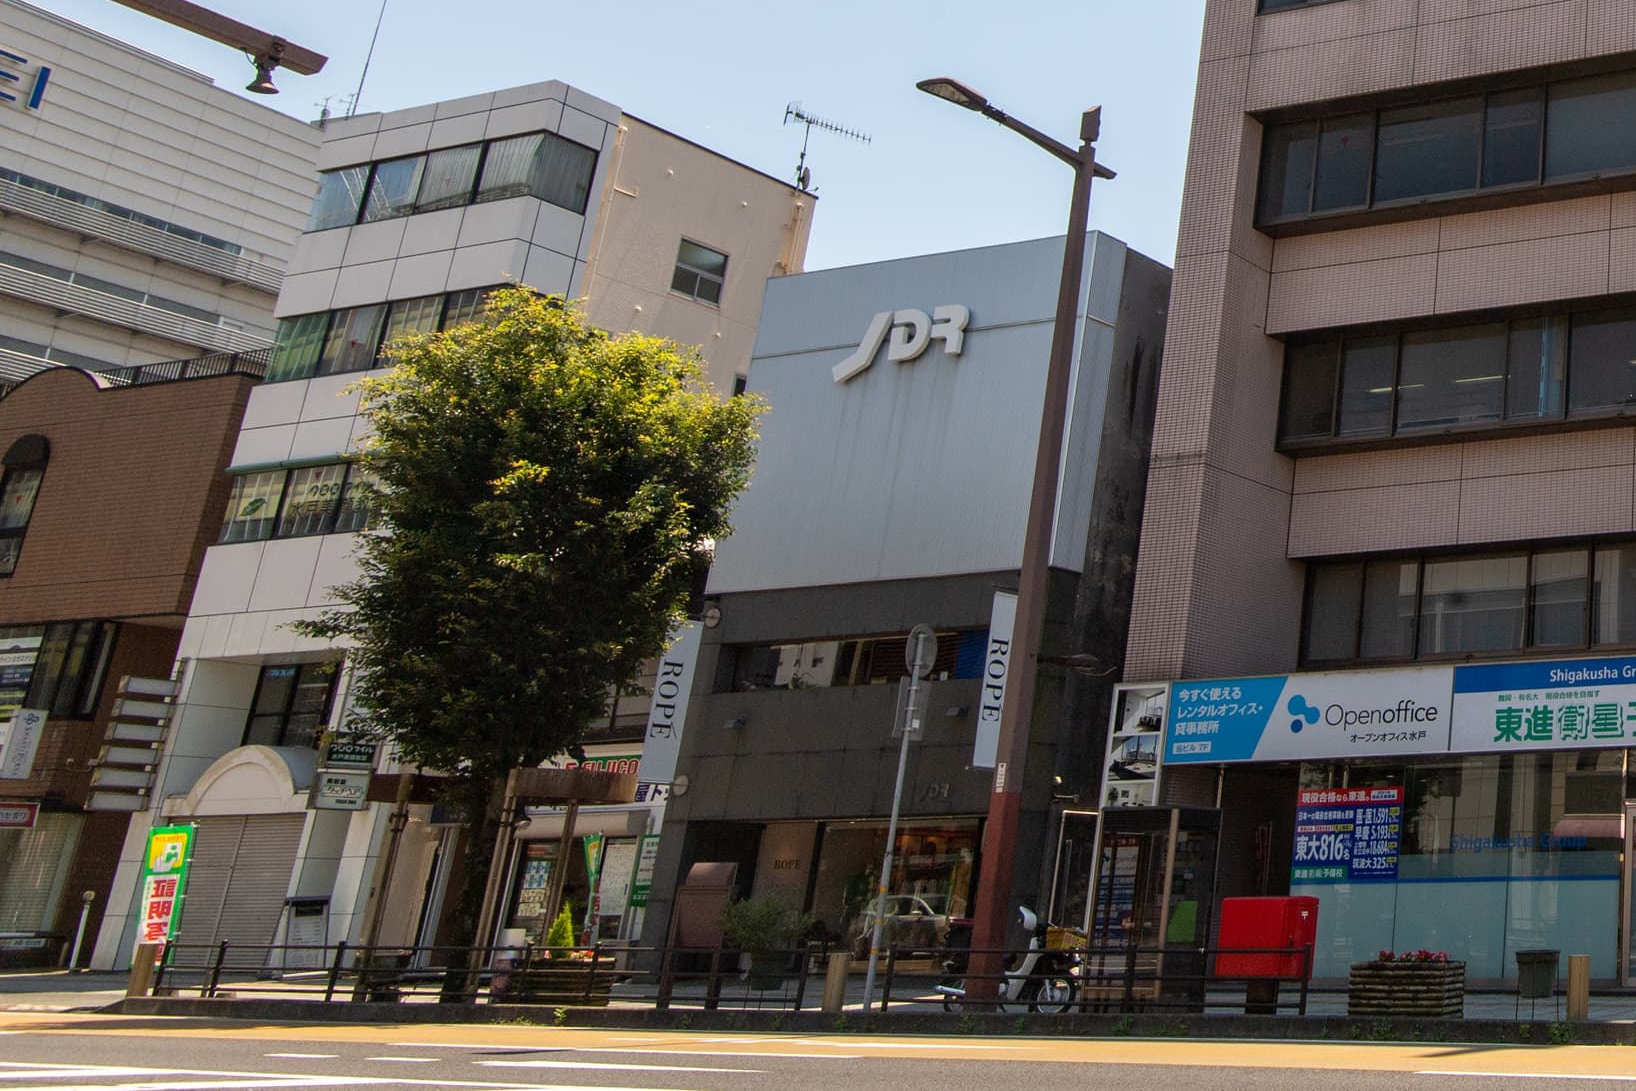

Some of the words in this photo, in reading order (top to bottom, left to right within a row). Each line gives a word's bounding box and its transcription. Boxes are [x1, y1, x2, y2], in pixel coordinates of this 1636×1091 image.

[1550, 668, 1618, 684] Shigakusha
[1179, 687, 1242, 702] 今すぐ使える
[1325, 699, 1438, 731] Openoffice
[1175, 720, 1219, 736] 貸事務所
[1350, 730, 1427, 743] オープンオフィス水戸
